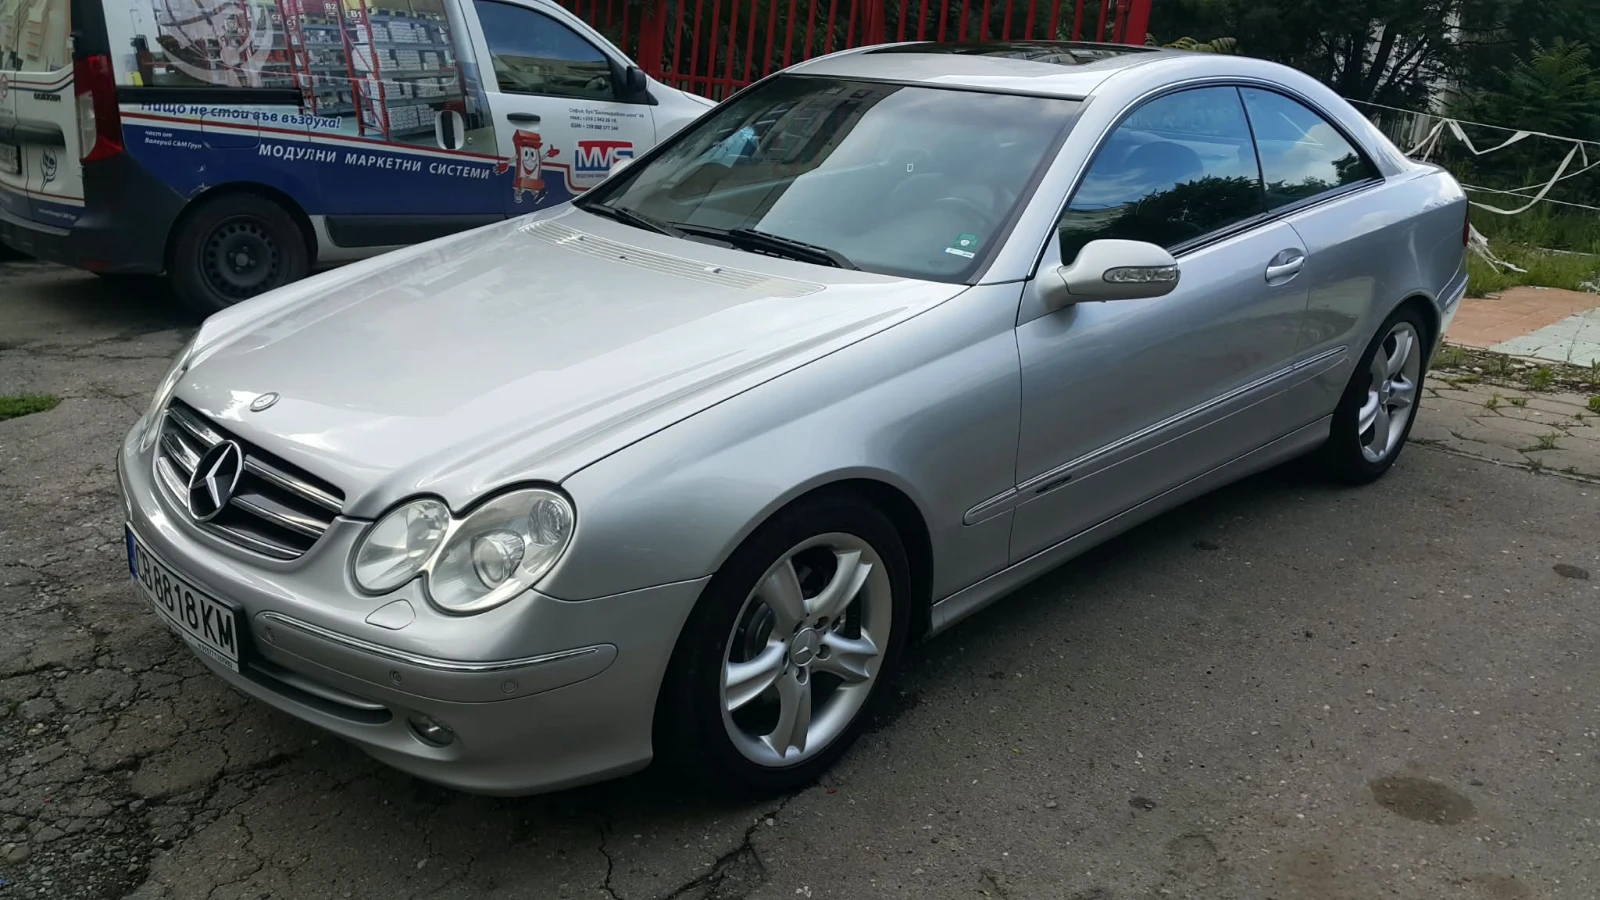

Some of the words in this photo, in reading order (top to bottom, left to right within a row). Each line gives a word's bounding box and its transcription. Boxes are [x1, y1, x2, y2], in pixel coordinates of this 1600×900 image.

[189, 105, 208, 116] не
[210, 107, 249, 119] стои
[252, 111, 278, 122] във
[281, 114, 342, 129] въздуха!
[258, 143, 338, 162] МОДУЛНИ
[344, 153, 422, 172] МАРКЕТНИ
[428, 162, 491, 180] СИСТЕМИ
